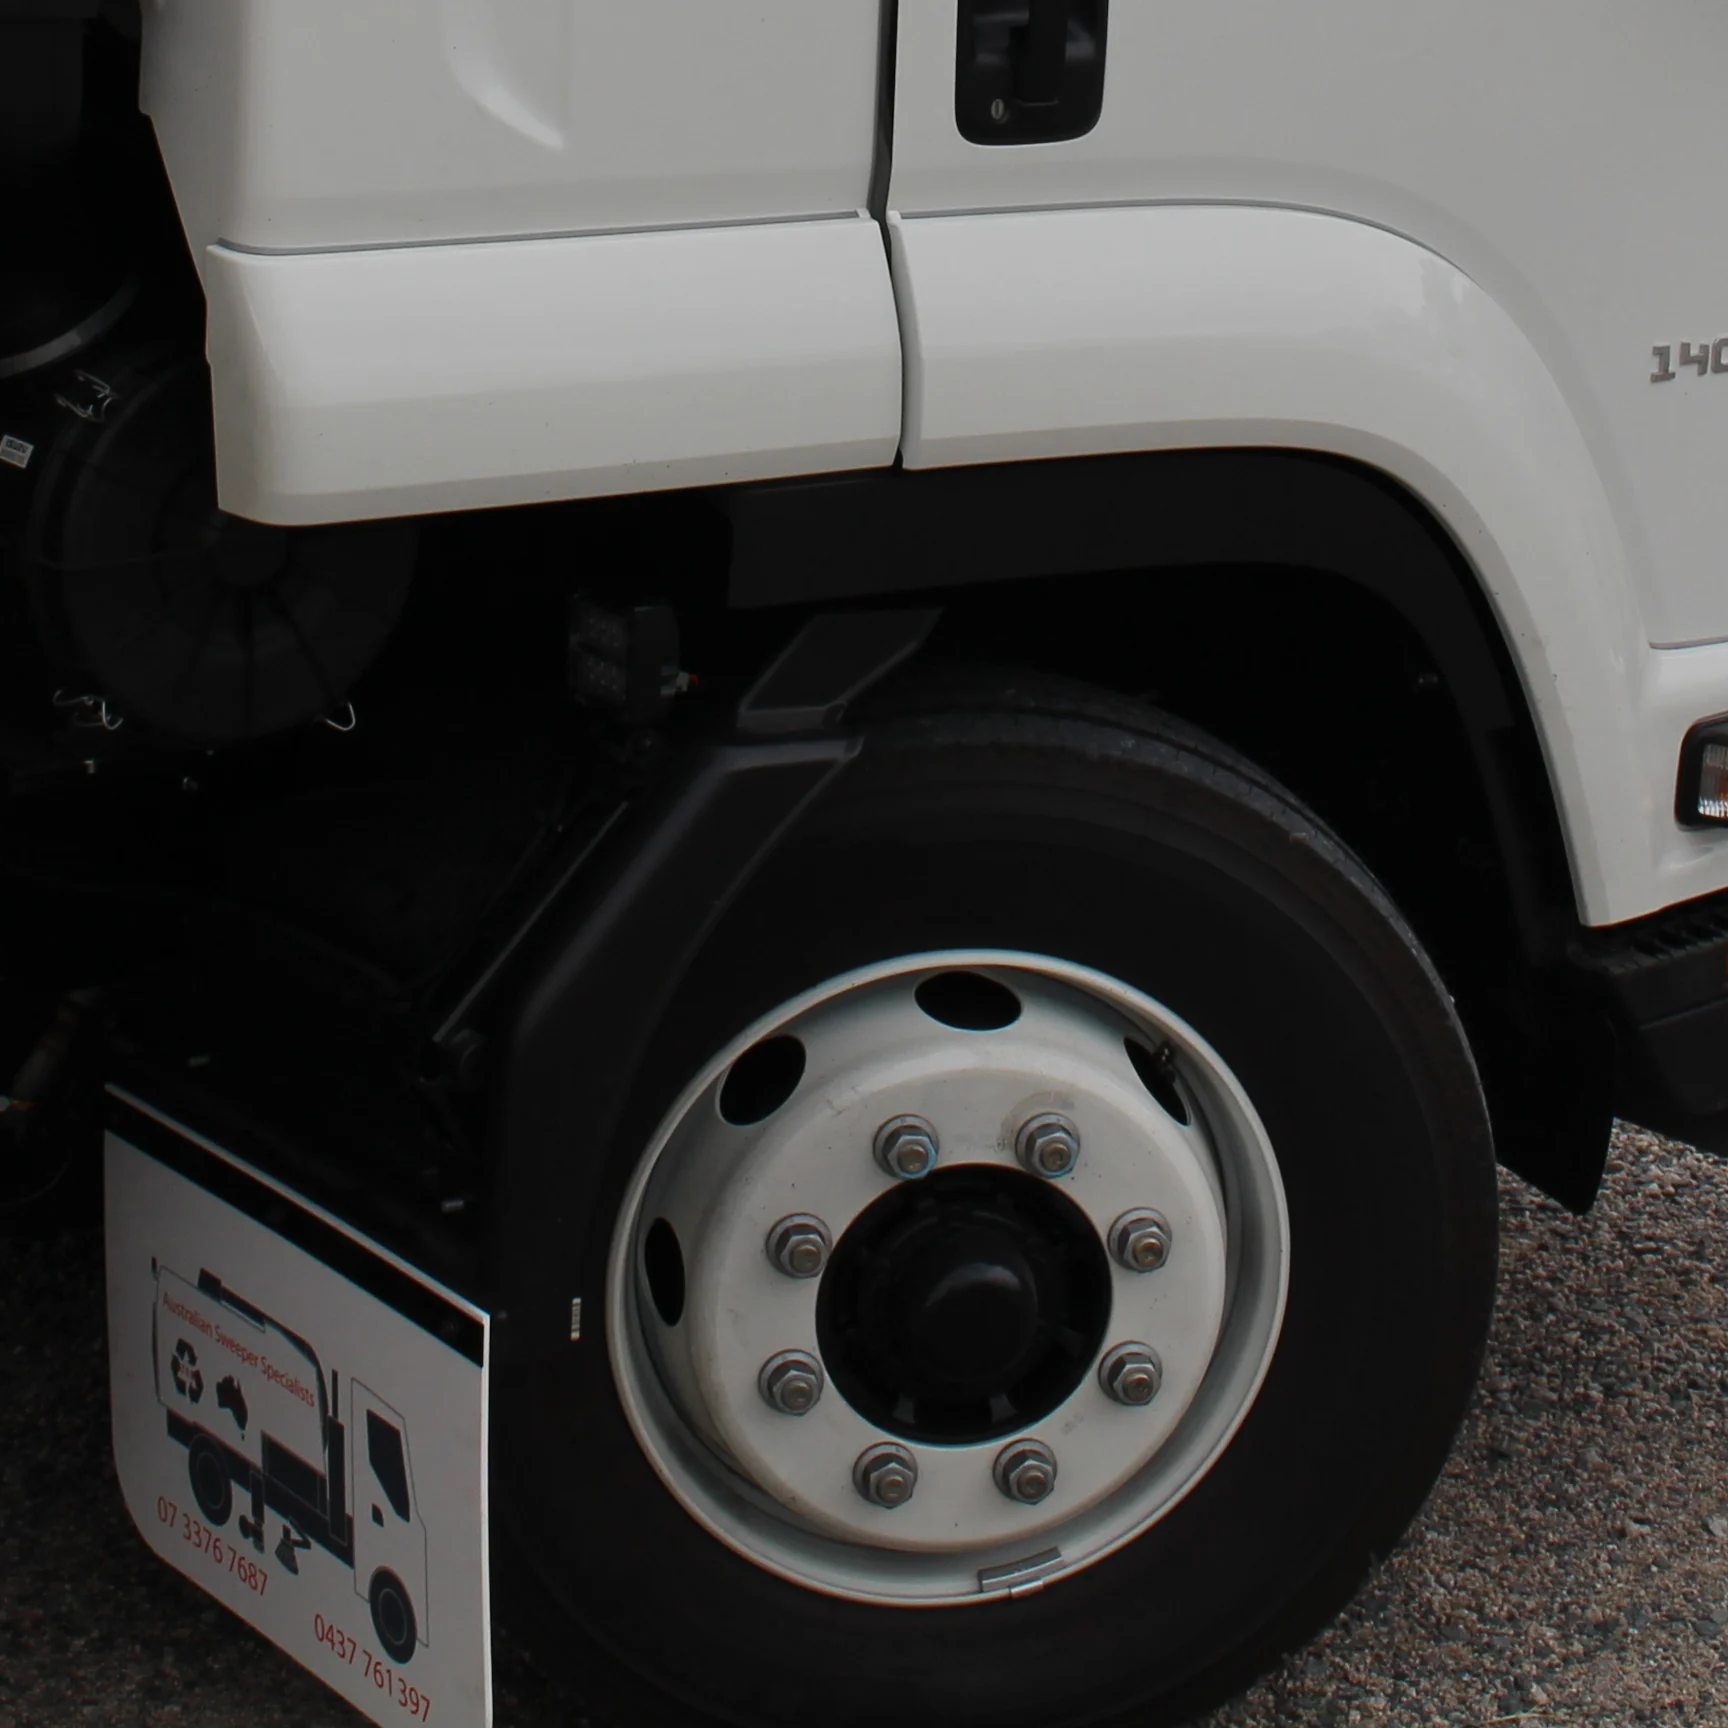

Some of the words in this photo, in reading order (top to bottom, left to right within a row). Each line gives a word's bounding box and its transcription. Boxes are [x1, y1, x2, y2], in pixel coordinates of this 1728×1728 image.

[162, 1291, 214, 1339] Australian
[214, 1325, 260, 1369] Sweeper
[261, 1356, 315, 1408] Specialists
[157, 1496, 178, 1528] 07
[183, 1513, 223, 1564] 3376
[227, 1544, 268, 1596] 7687
[314, 1613, 357, 1665] 0437
[362, 1649, 393, 1697] 761
[398, 1677, 430, 1723] 397
